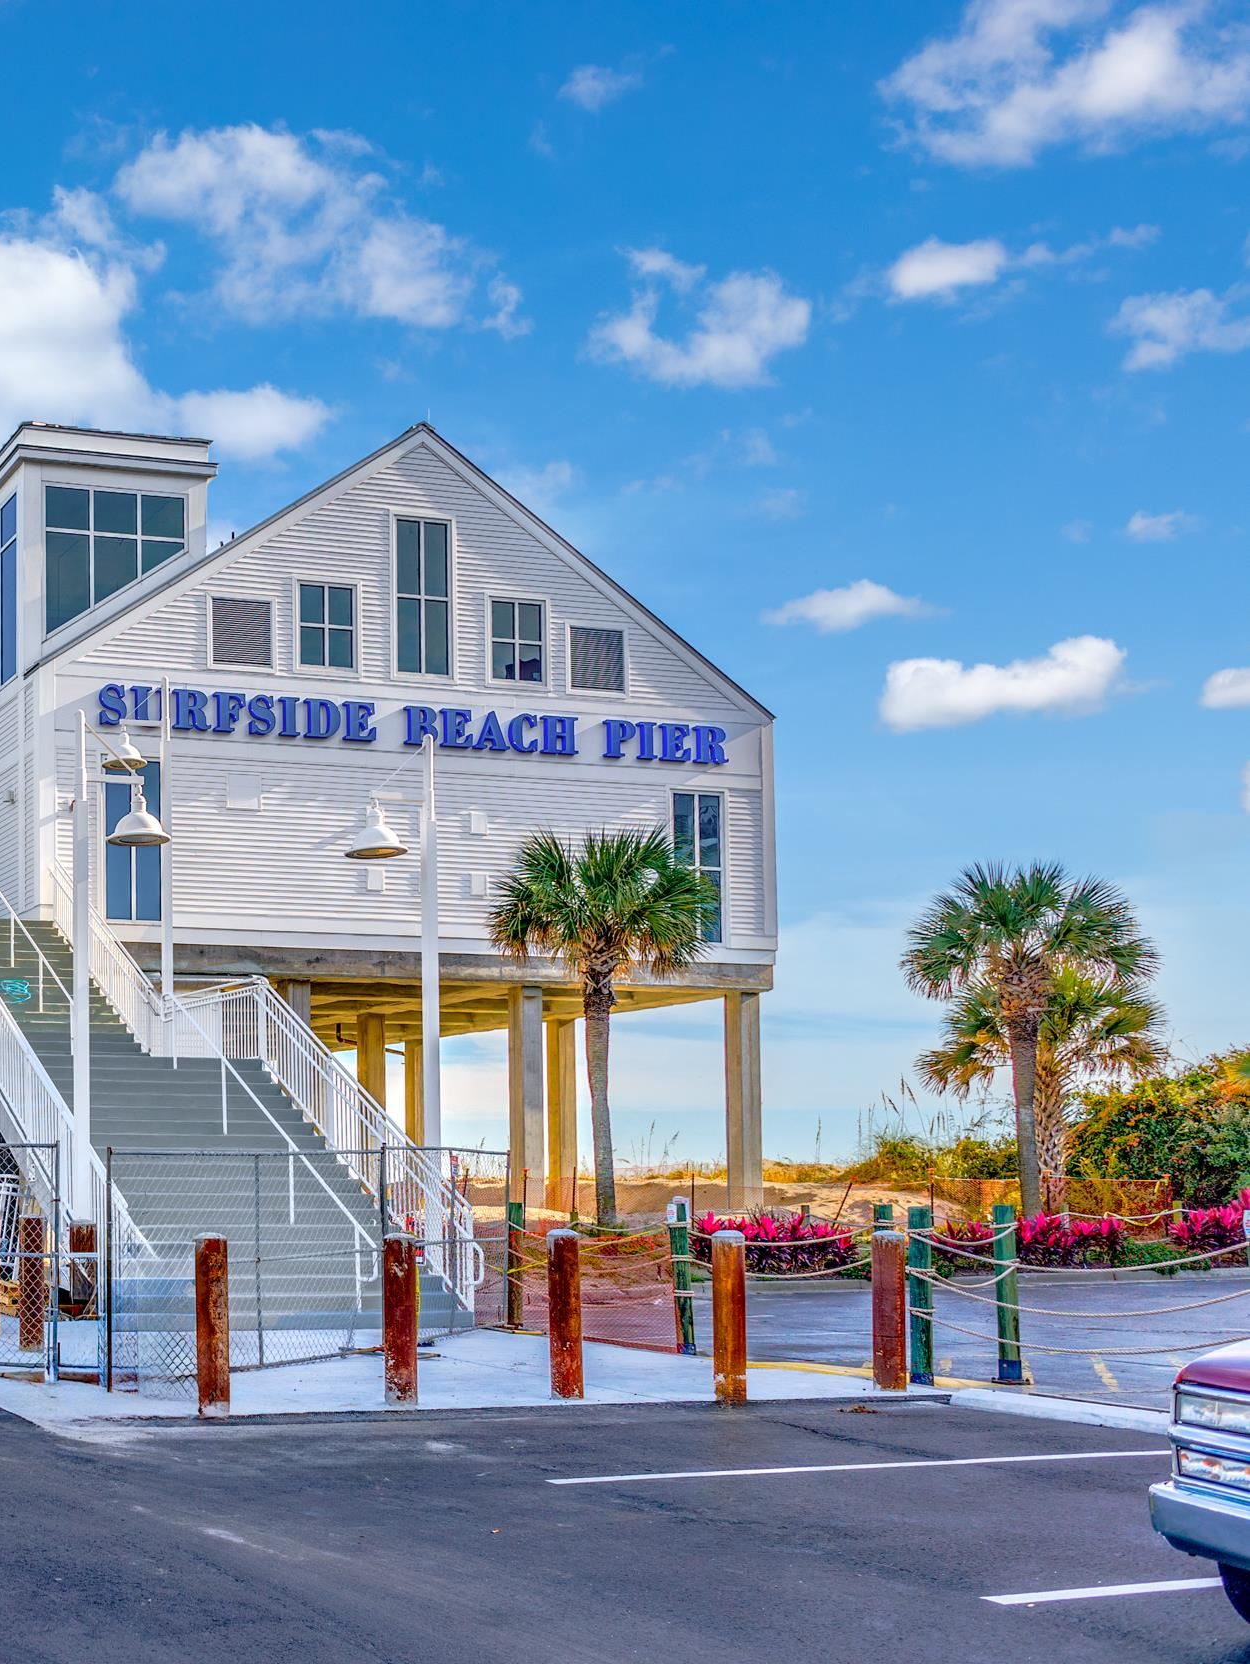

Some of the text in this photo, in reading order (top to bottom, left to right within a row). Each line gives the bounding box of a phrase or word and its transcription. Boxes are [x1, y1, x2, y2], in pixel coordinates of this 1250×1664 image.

[98, 683, 730, 765] SURFSIDE BEACH PIER
